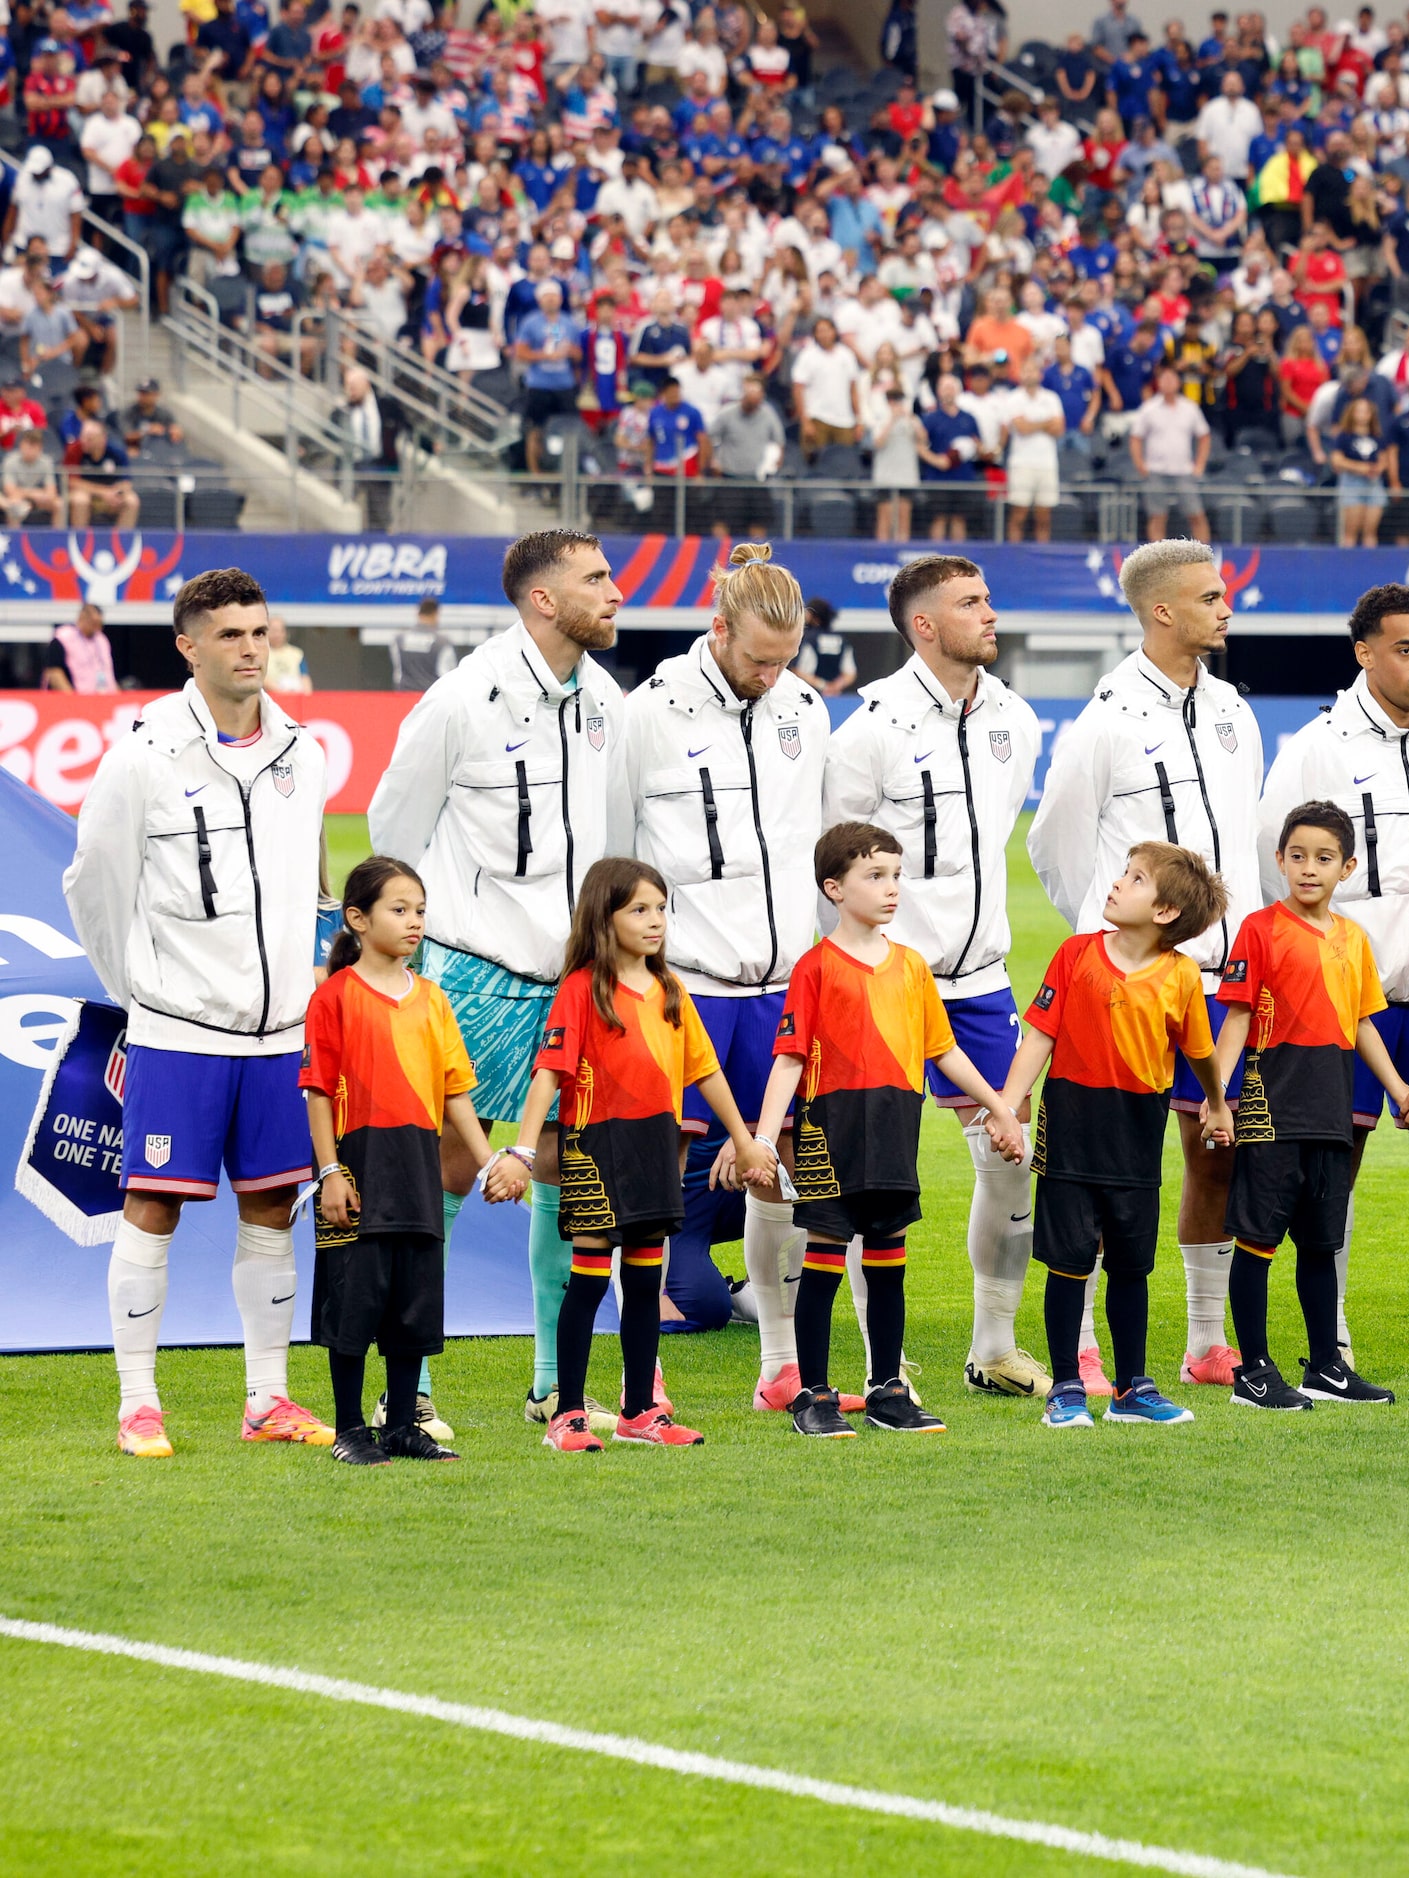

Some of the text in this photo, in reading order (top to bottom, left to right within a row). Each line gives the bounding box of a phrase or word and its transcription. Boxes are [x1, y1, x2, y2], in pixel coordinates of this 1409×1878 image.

[328, 543, 448, 580] VIBRA
[589, 719, 603, 732] USA
[1217, 724, 1233, 737] USA
[780, 728, 798, 742] USA
[991, 732, 1008, 745] USA
[272, 766, 291, 779] USA
[53, 1113, 97, 1142] ONE
[148, 1136, 170, 1150] USA
[53, 1139, 97, 1168] ONE
